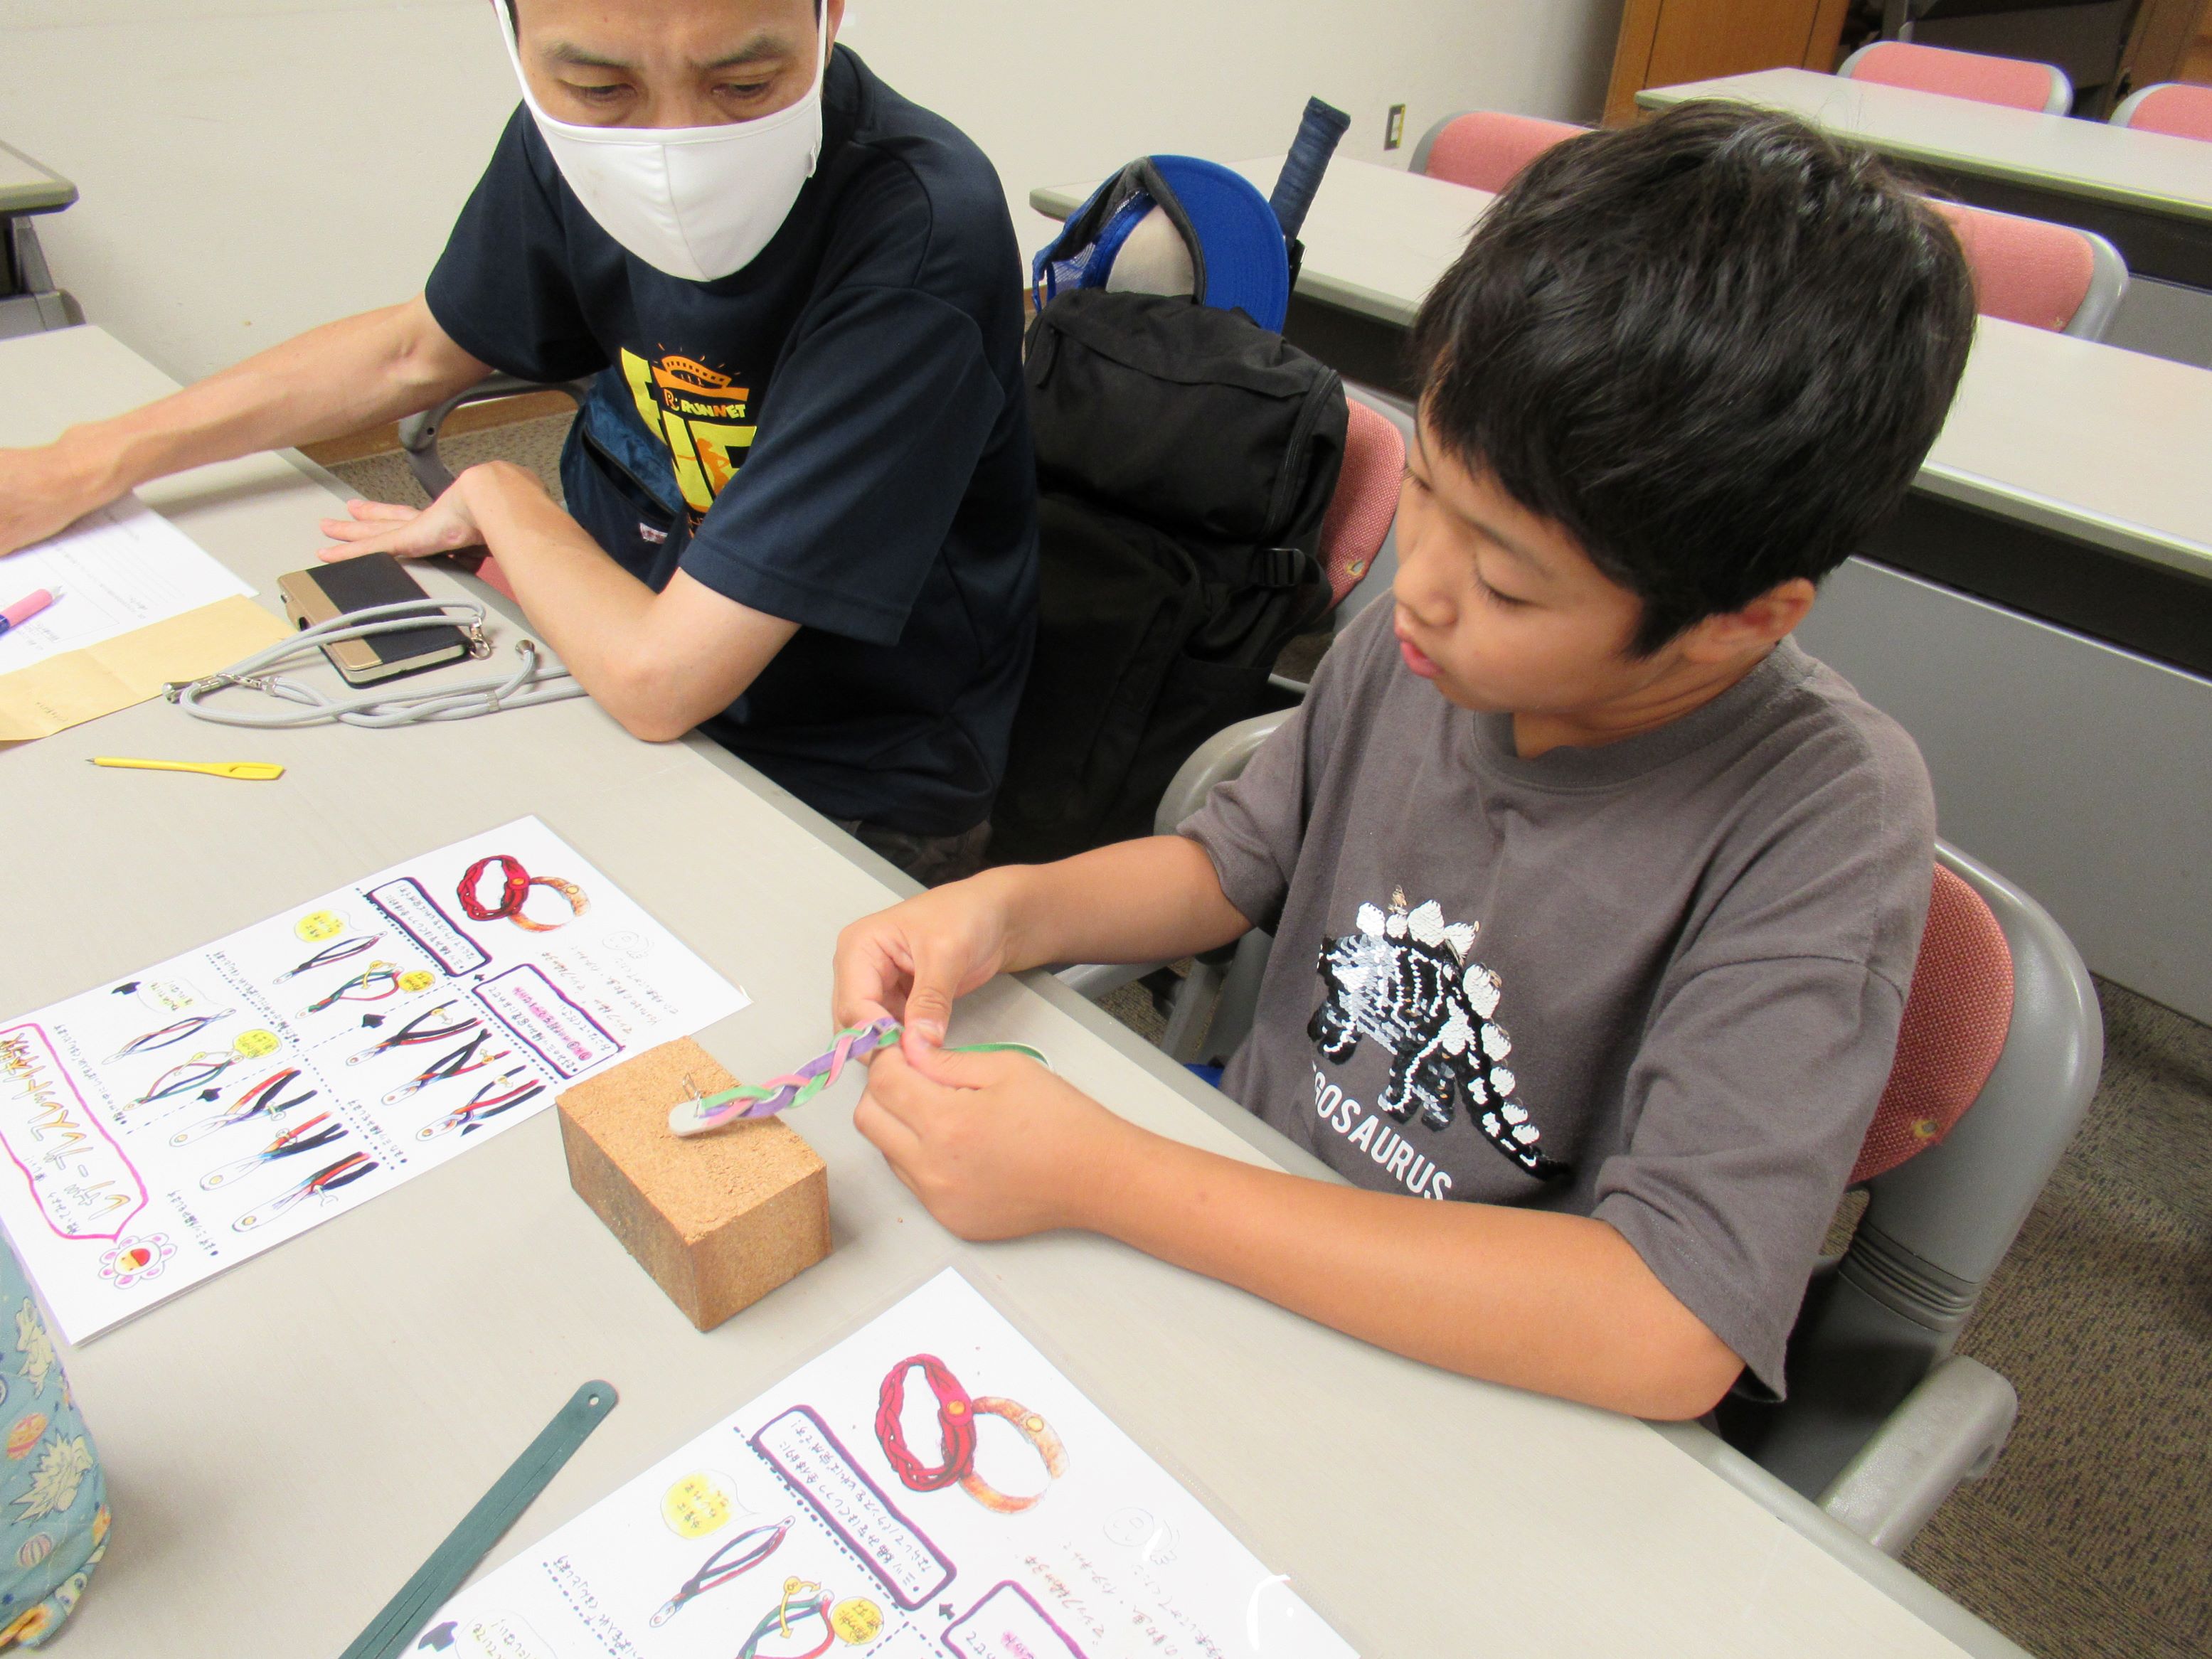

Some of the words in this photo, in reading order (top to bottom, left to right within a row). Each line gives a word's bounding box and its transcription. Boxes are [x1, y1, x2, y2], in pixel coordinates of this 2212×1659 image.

[681, 399, 747, 420] RUNNET
[0, 1031, 133, 1223] レザーブレスレット体験
[1313, 1071, 1452, 1200] GOSAURUS
